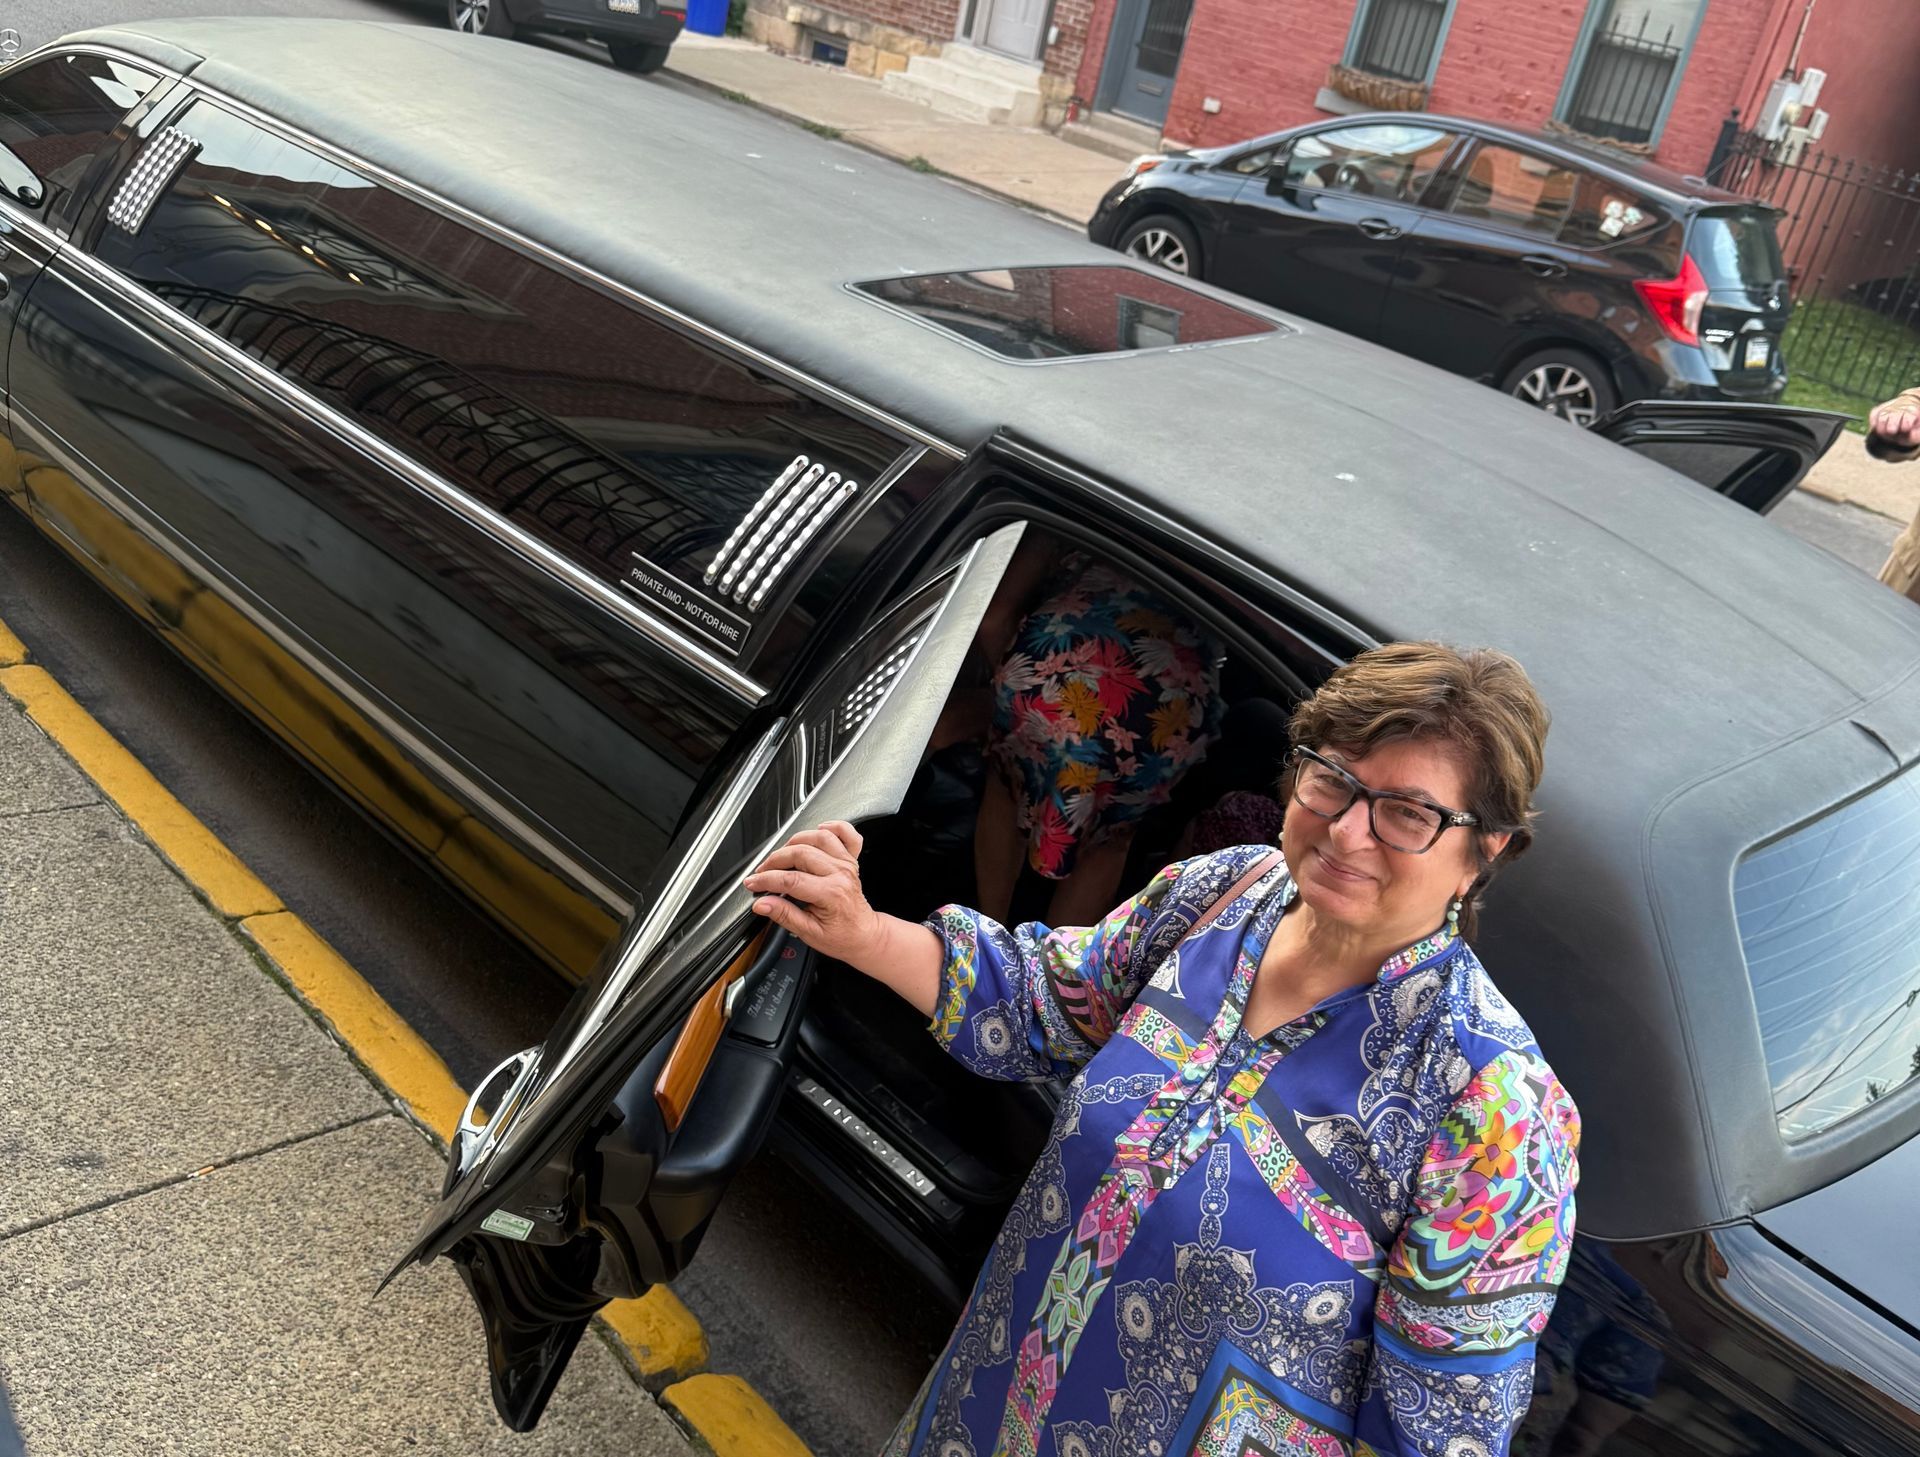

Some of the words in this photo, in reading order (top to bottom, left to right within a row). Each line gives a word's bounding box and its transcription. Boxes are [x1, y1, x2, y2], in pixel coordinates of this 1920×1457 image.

[631, 568, 663, 594] PRIVATE
[662, 586, 682, 605] LIMO
[685, 601, 703, 618] NOT
[701, 613, 720, 629] FOR
[718, 622, 740, 641] HIRE
[803, 1086, 926, 1188] LINCOLN
